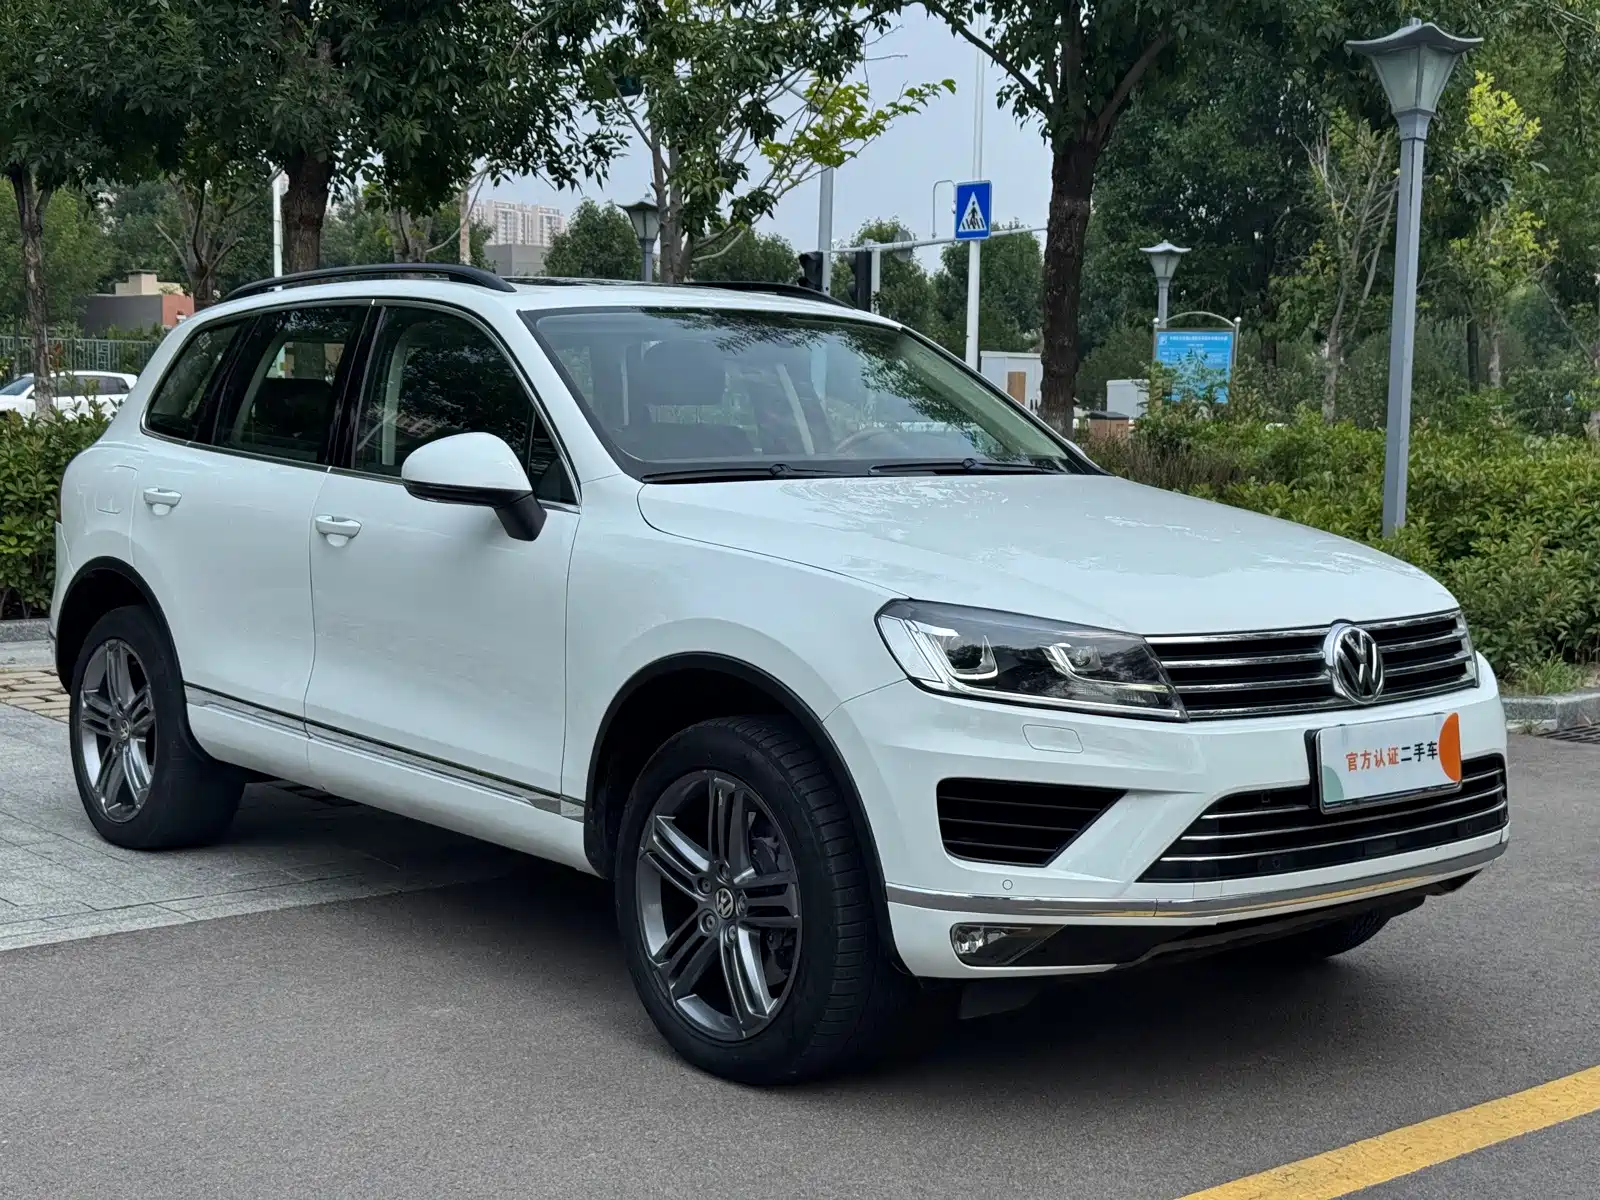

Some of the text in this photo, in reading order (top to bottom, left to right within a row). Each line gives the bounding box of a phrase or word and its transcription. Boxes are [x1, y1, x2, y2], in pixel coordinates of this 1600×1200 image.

[1345, 741, 1438, 772] 官方认证二手车
